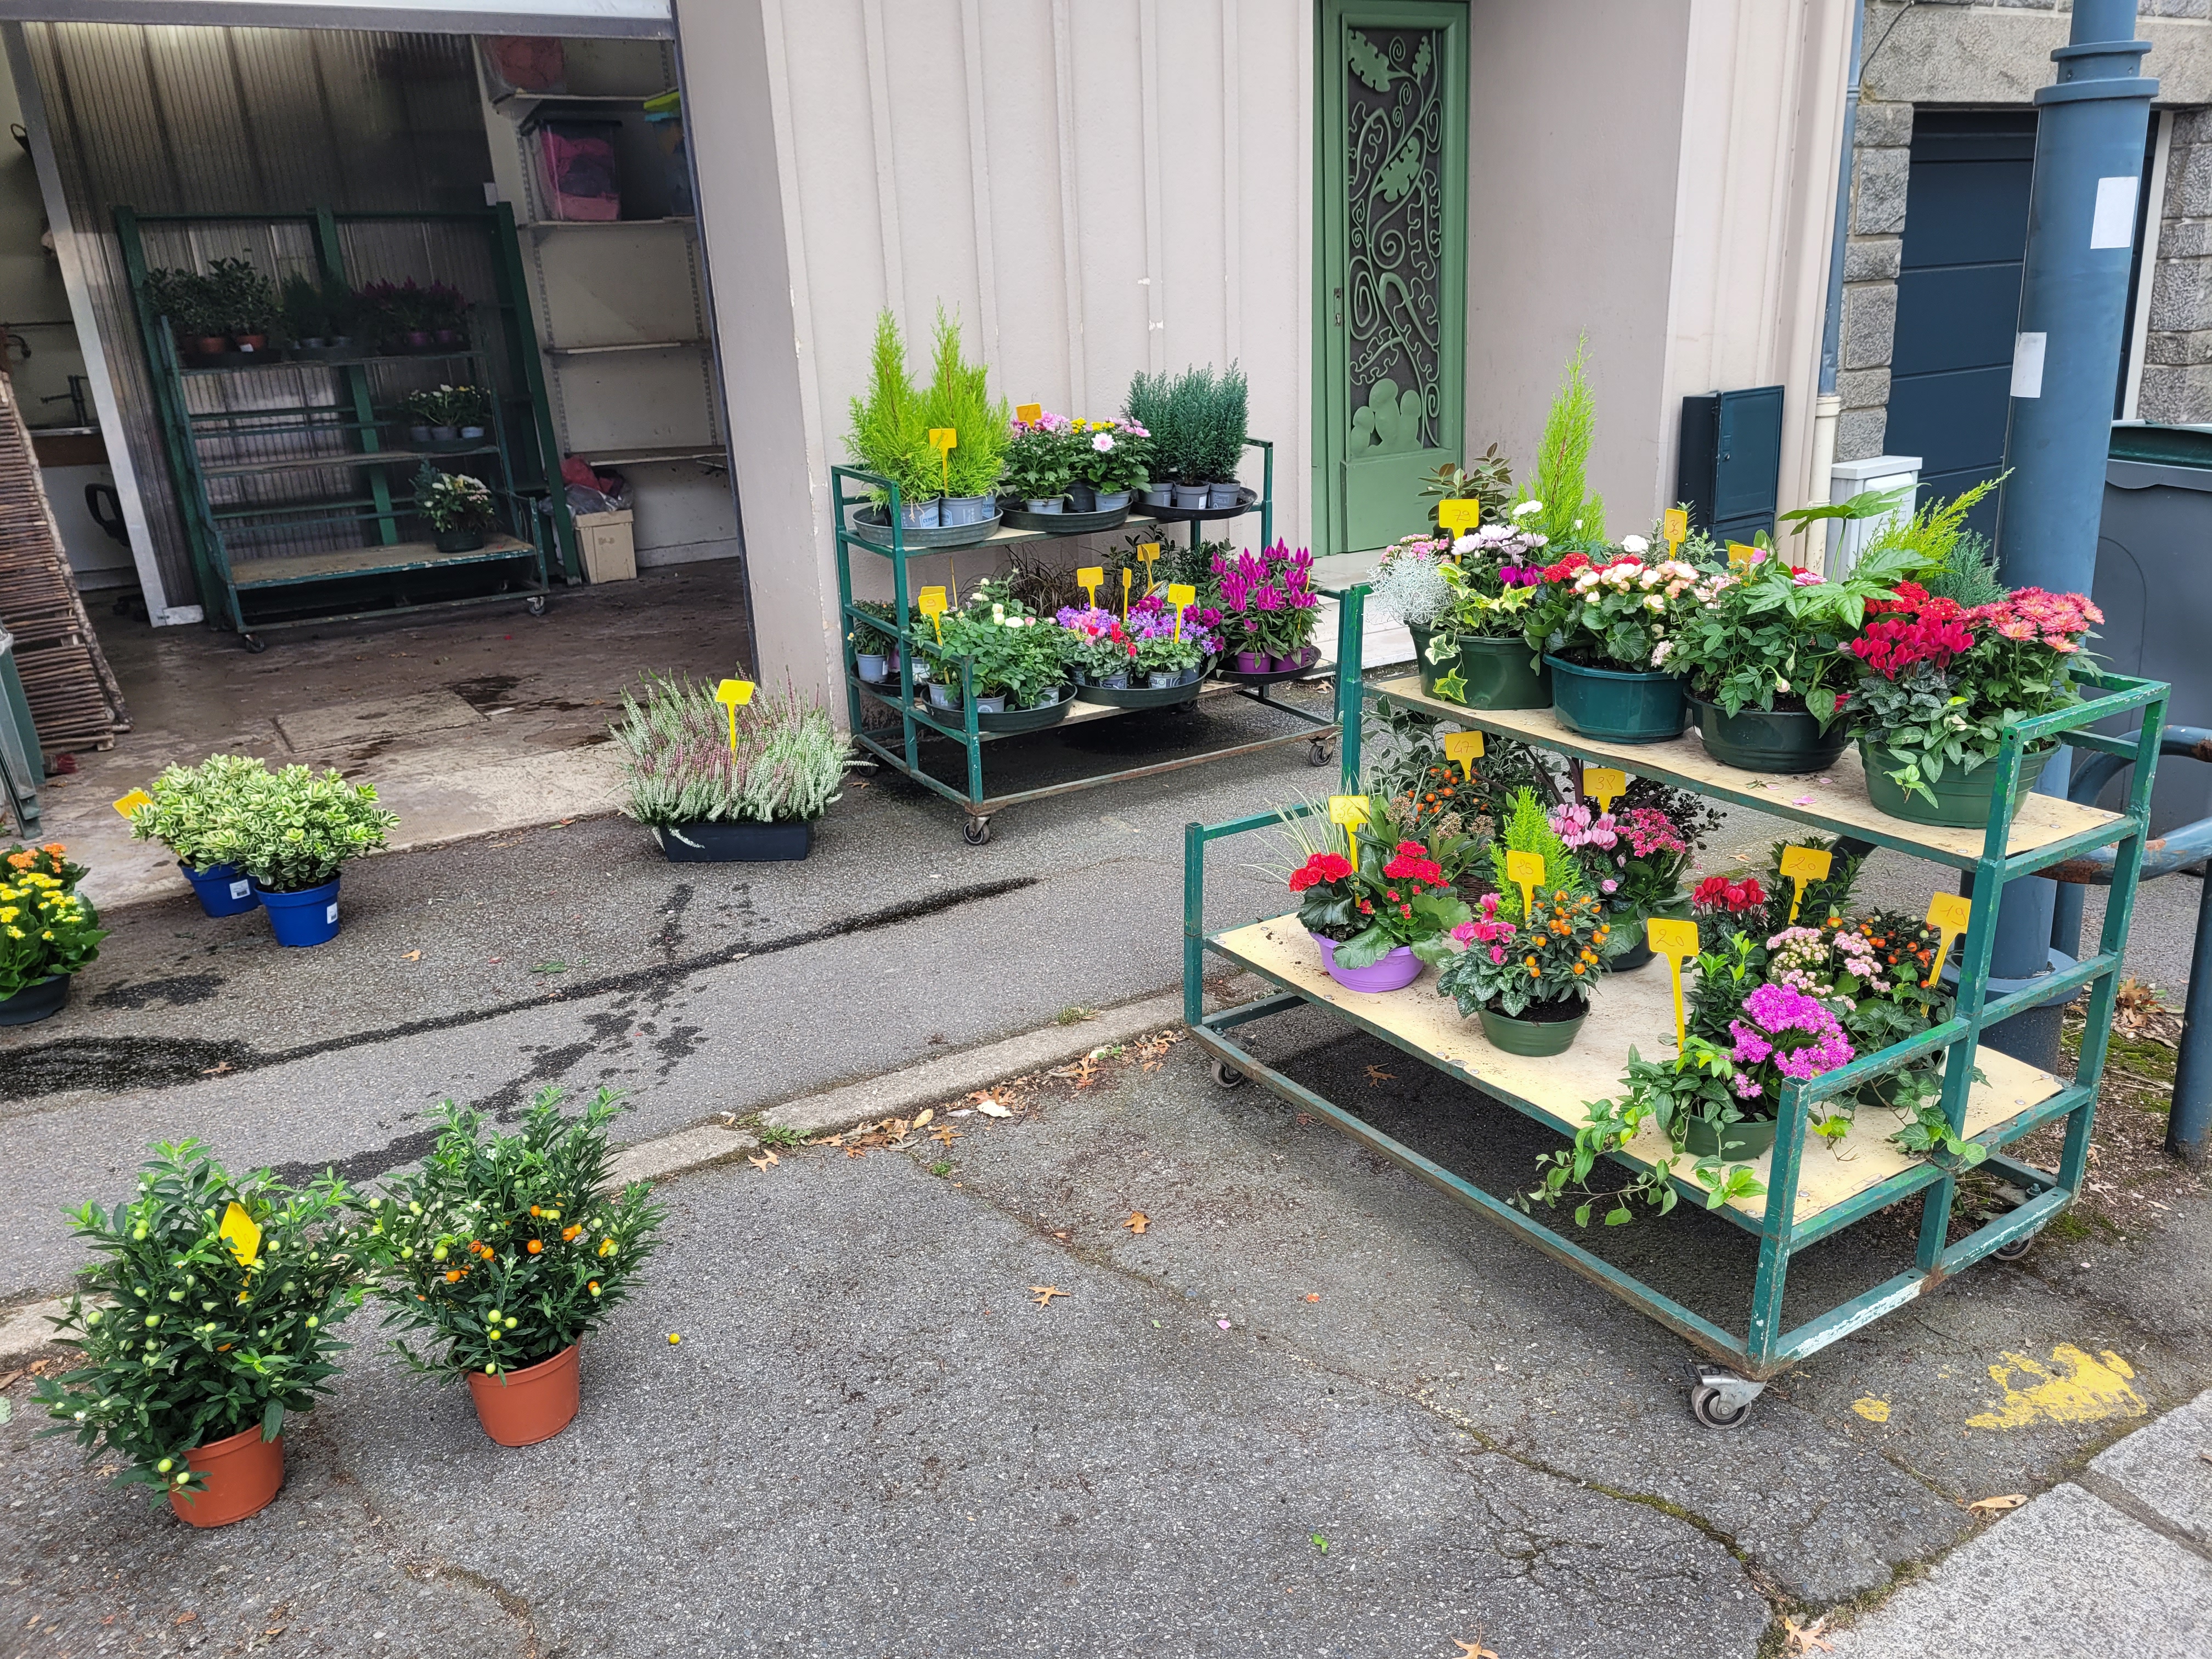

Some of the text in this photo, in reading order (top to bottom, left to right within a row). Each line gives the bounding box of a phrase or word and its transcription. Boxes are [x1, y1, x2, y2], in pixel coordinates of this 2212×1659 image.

[1451, 509, 1471, 522] 79
[1176, 589, 1184, 601] 6
[926, 599, 936, 607] 9
[1454, 740, 1474, 754] 47
[1595, 775, 1616, 790] 38
[1336, 802, 1355, 819] 36
[1516, 859, 1534, 875] 25
[1788, 856, 1816, 871] 20
[1940, 905, 1967, 926] 19
[1656, 929, 1684, 947] 20
